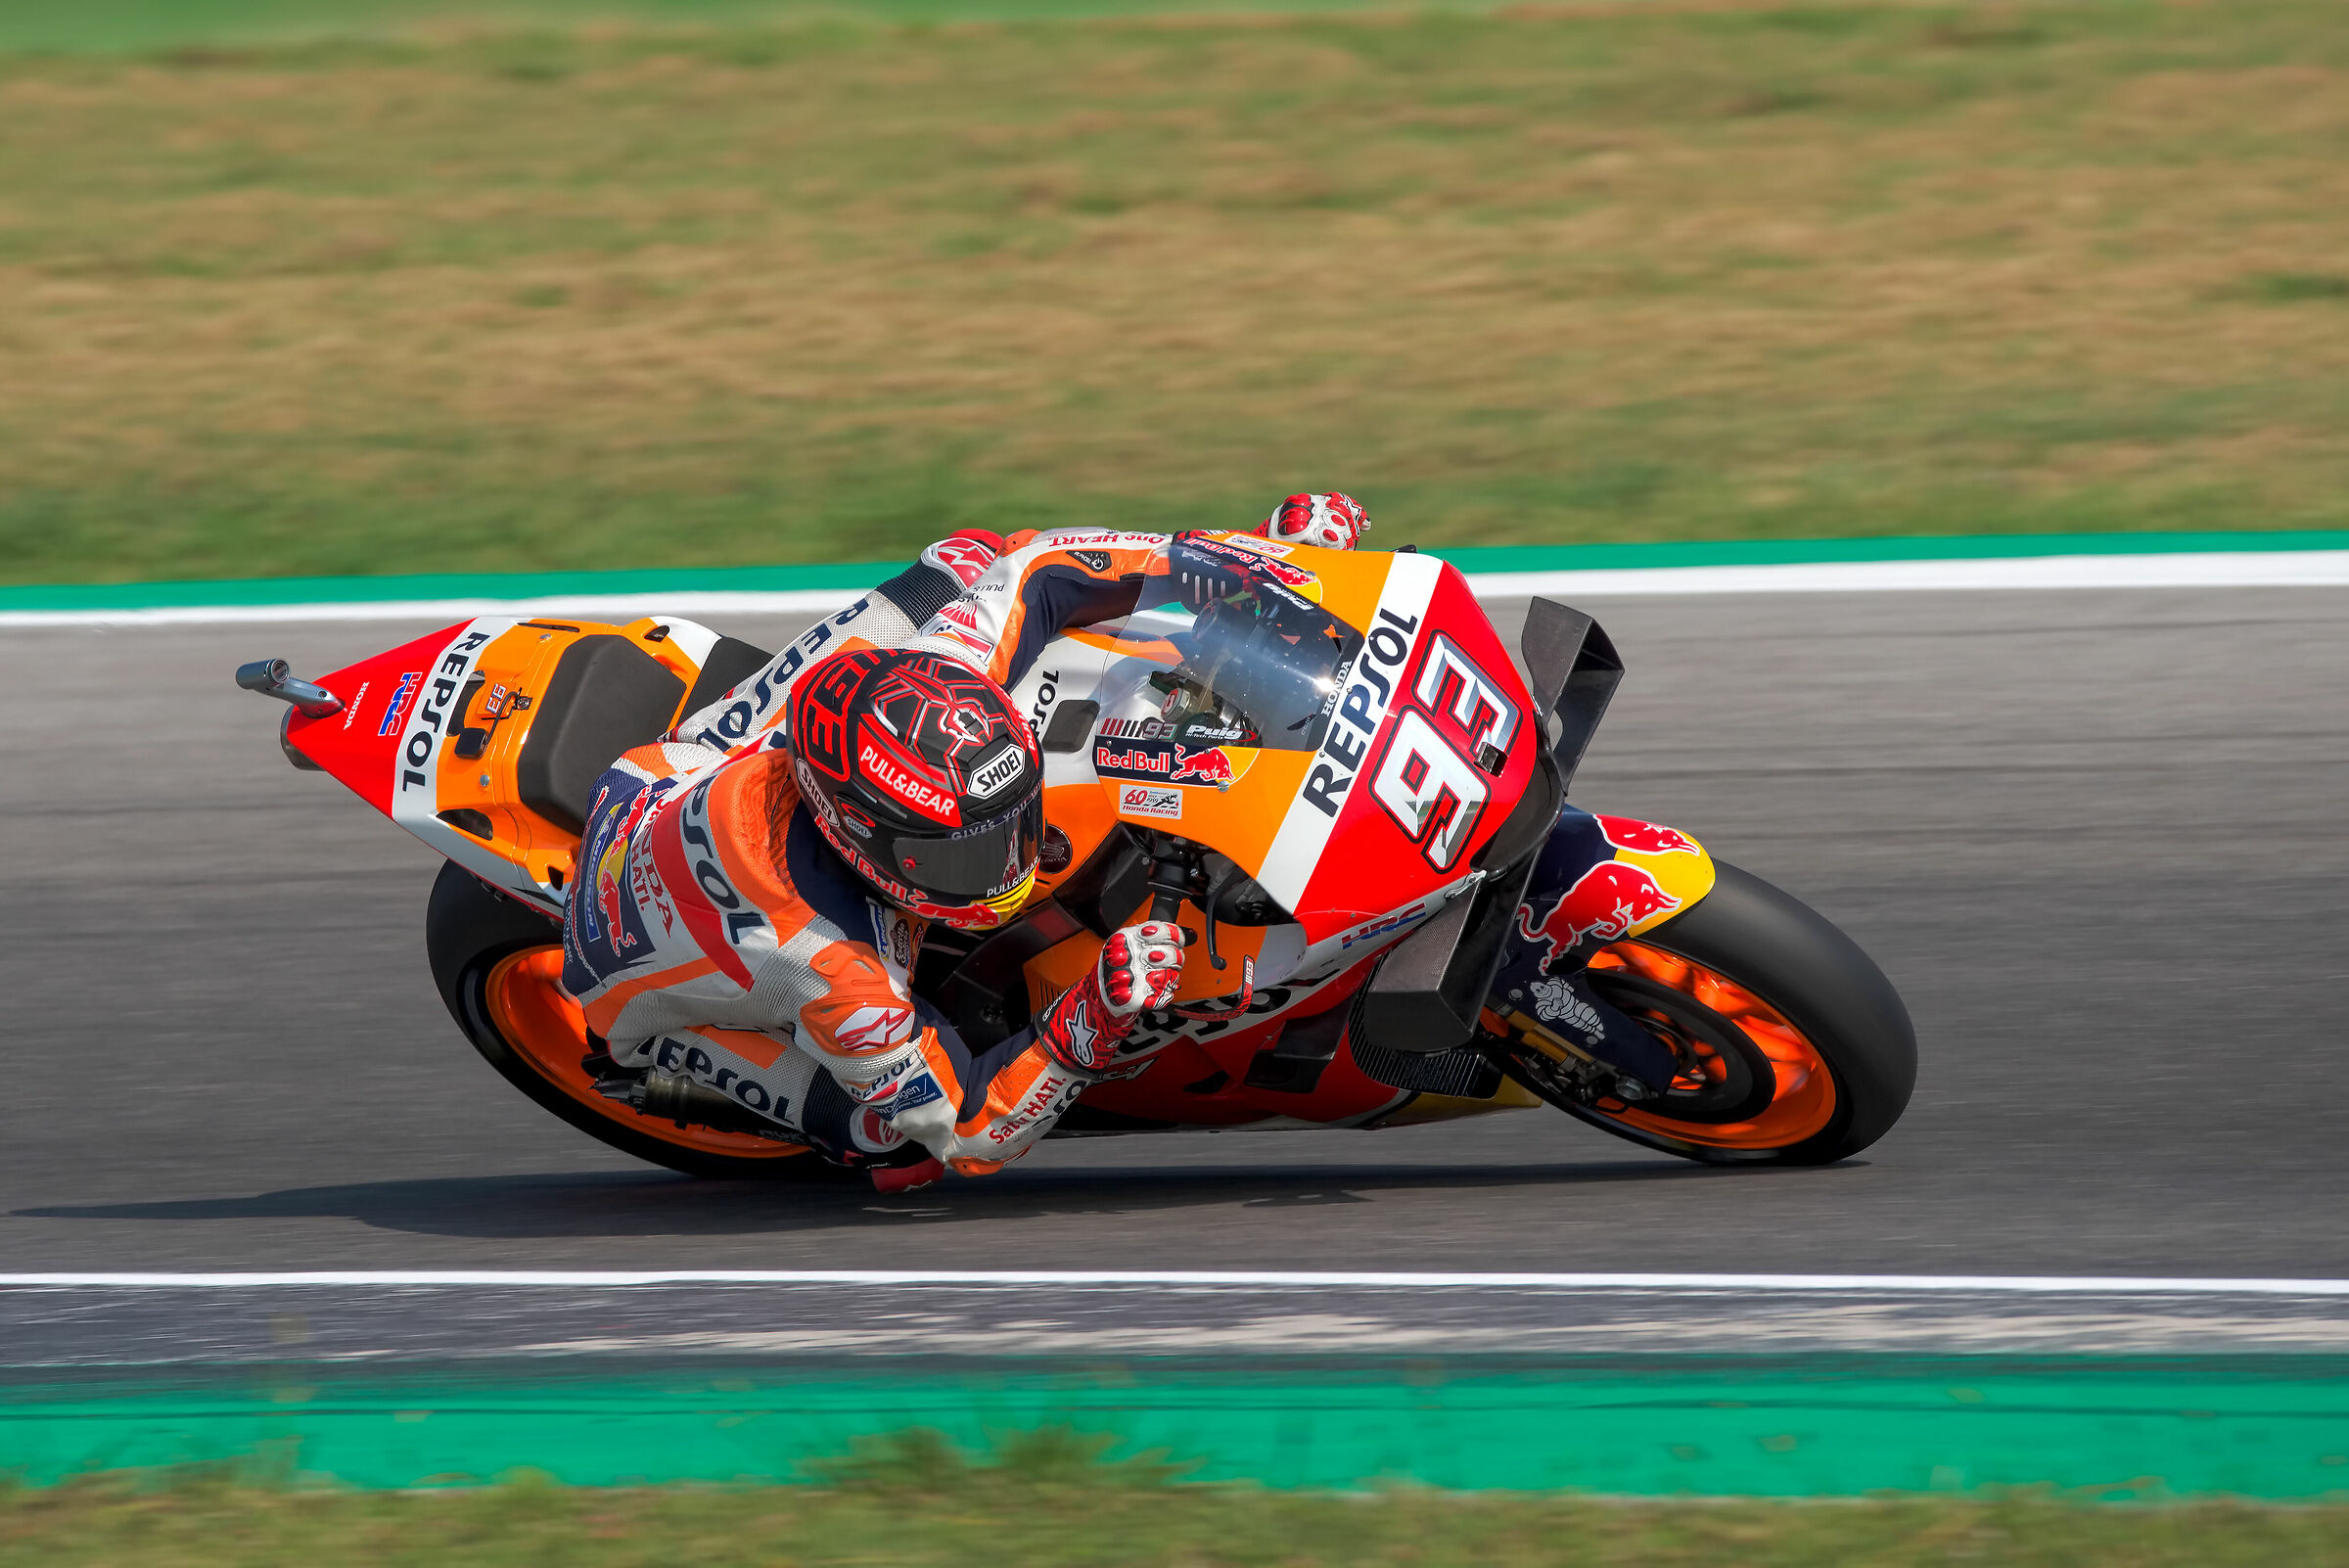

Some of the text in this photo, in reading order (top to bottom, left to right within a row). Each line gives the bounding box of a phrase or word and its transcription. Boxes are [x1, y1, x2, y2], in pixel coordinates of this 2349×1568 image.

[1049, 533, 1118, 547] HEART
[1183, 538, 1223, 553] Bull
[1219, 545, 1258, 564] Red
[485, 683, 507, 715] 93
[697, 598, 869, 753] REPSOL
[1321, 660, 1352, 717] HONDA
[344, 681, 370, 730] HONDA
[378, 672, 423, 737] HRC
[402, 631, 490, 793] REPSOL
[1032, 669, 1060, 737] PSOL
[1303, 608, 1418, 818] REPSOL
[1143, 721, 1179, 743] 93
[1187, 724, 1245, 740] Puig
[1371, 632, 1521, 871] 93
[860, 745, 955, 816] PULL&BEAR
[977, 751, 1023, 793] SHOEI
[1097, 746, 1171, 773] Red Bull
[801, 766, 832, 819] SHOEI
[1123, 805, 1178, 816] Honda Racing
[1125, 789, 1148, 806] 60
[683, 774, 766, 945] PSOL
[813, 813, 907, 901] Red Bull
[987, 856, 1039, 899] PULL&BEAR
[642, 832, 673, 940] NDA
[1341, 902, 1427, 949] HRC
[989, 1113, 1030, 1144] Satu
[1023, 1077, 1067, 1118] HATI.
